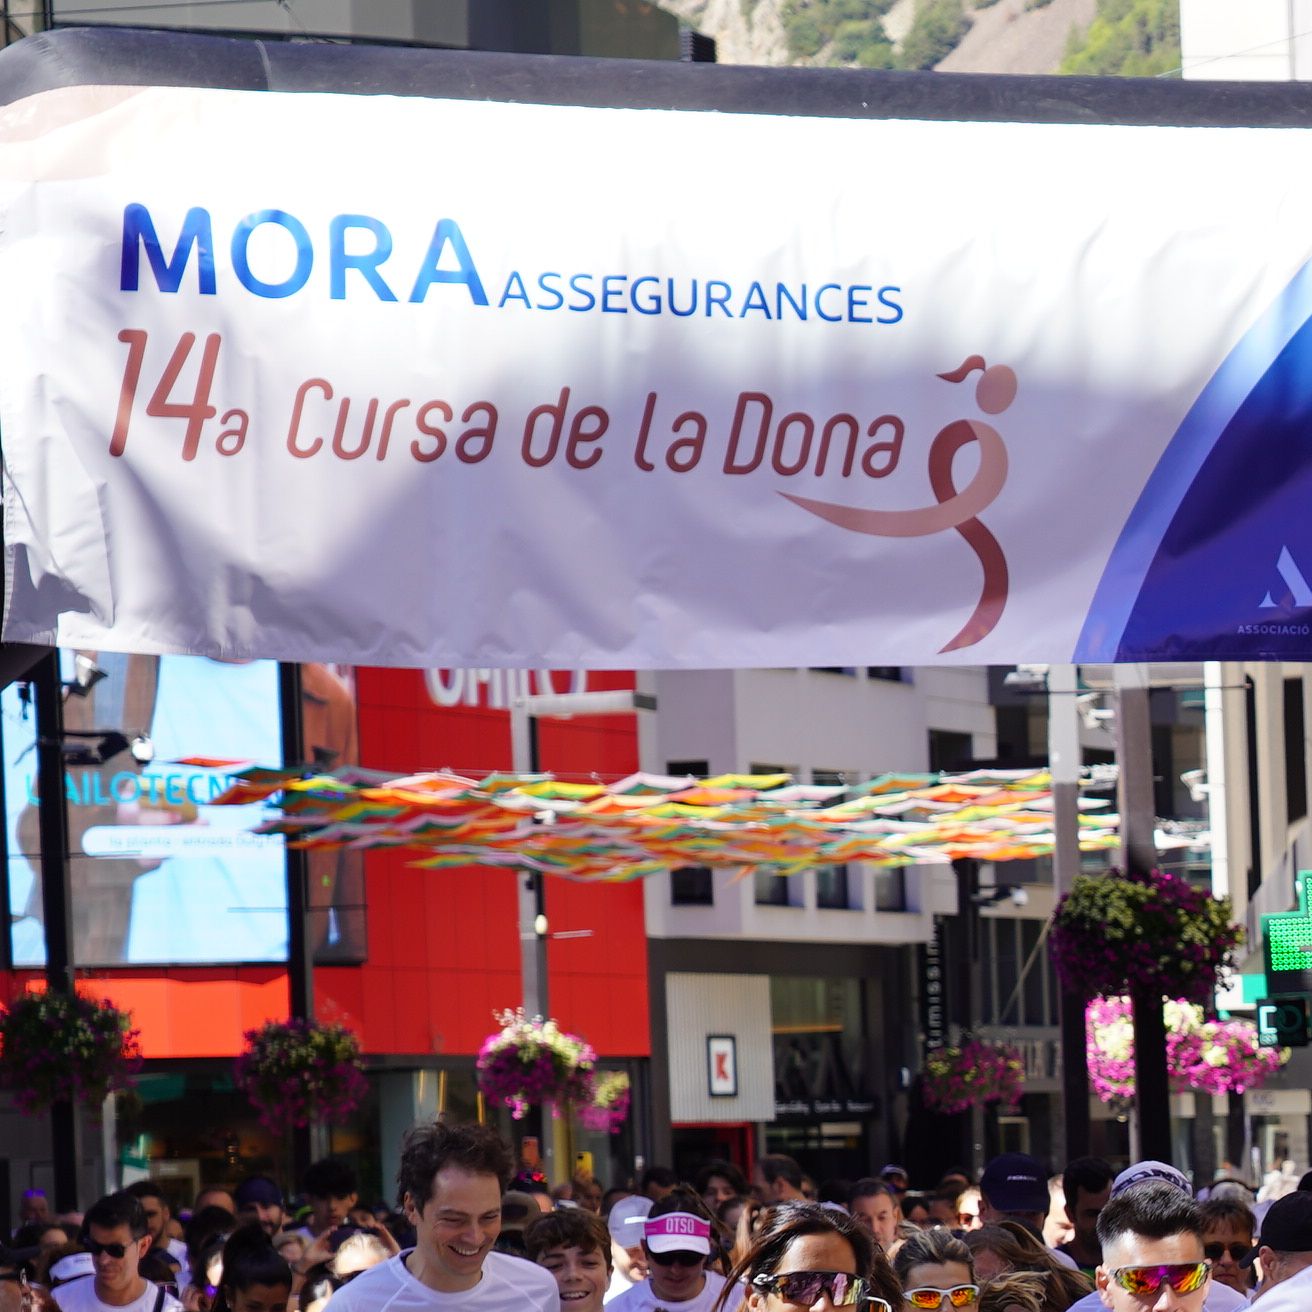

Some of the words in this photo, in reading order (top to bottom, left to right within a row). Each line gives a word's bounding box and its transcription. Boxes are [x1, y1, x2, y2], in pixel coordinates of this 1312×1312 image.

[119, 202, 490, 307] MORA
[498, 269, 905, 325] ASSEGURANCES
[108, 328, 250, 463] 14a
[286, 377, 498, 466] Cursa
[520, 386, 606, 472] de
[634, 389, 709, 475] la
[722, 391, 906, 480] Dona
[1236, 623, 1310, 636] ASSOCIACIÓ
[665, 1217, 695, 1234] OTSO
